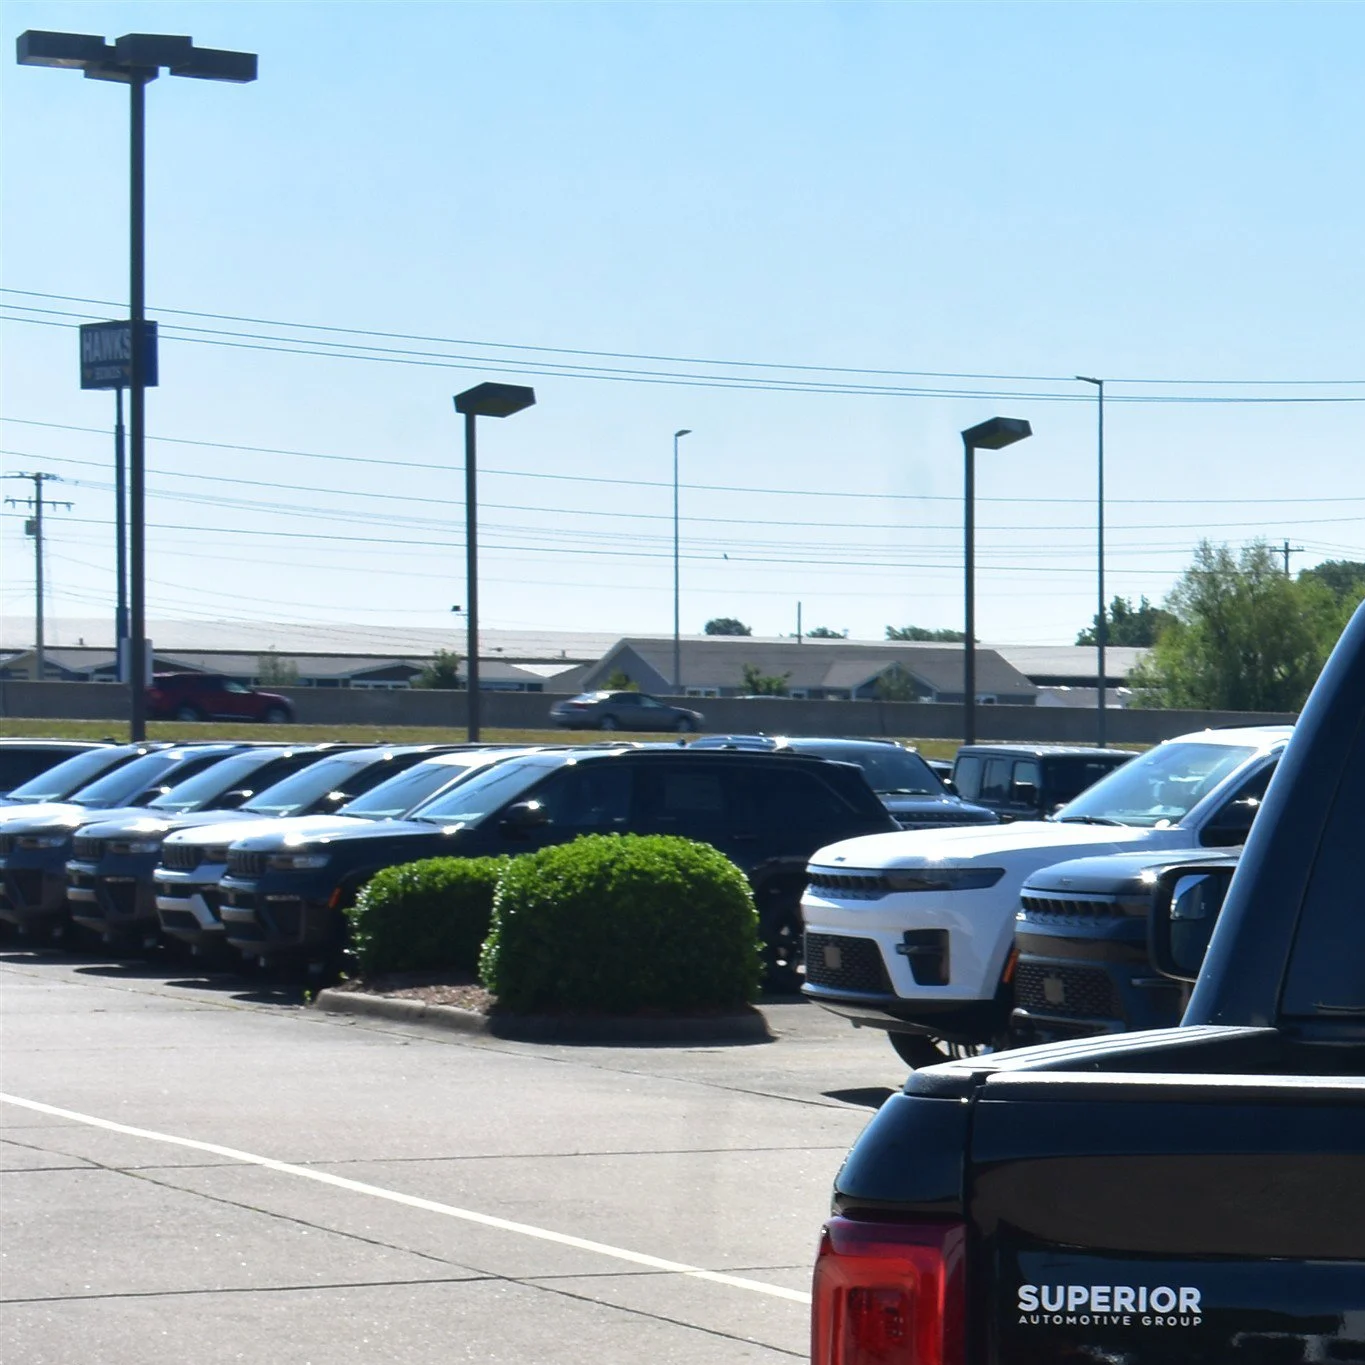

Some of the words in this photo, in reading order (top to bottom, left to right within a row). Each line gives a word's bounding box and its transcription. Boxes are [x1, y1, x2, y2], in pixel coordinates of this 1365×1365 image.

[1017, 1284, 1202, 1314] SUPERIOR
[1018, 1314, 1132, 1327] AUTOMOTIVE
[1141, 1316, 1202, 1327] GROUP
